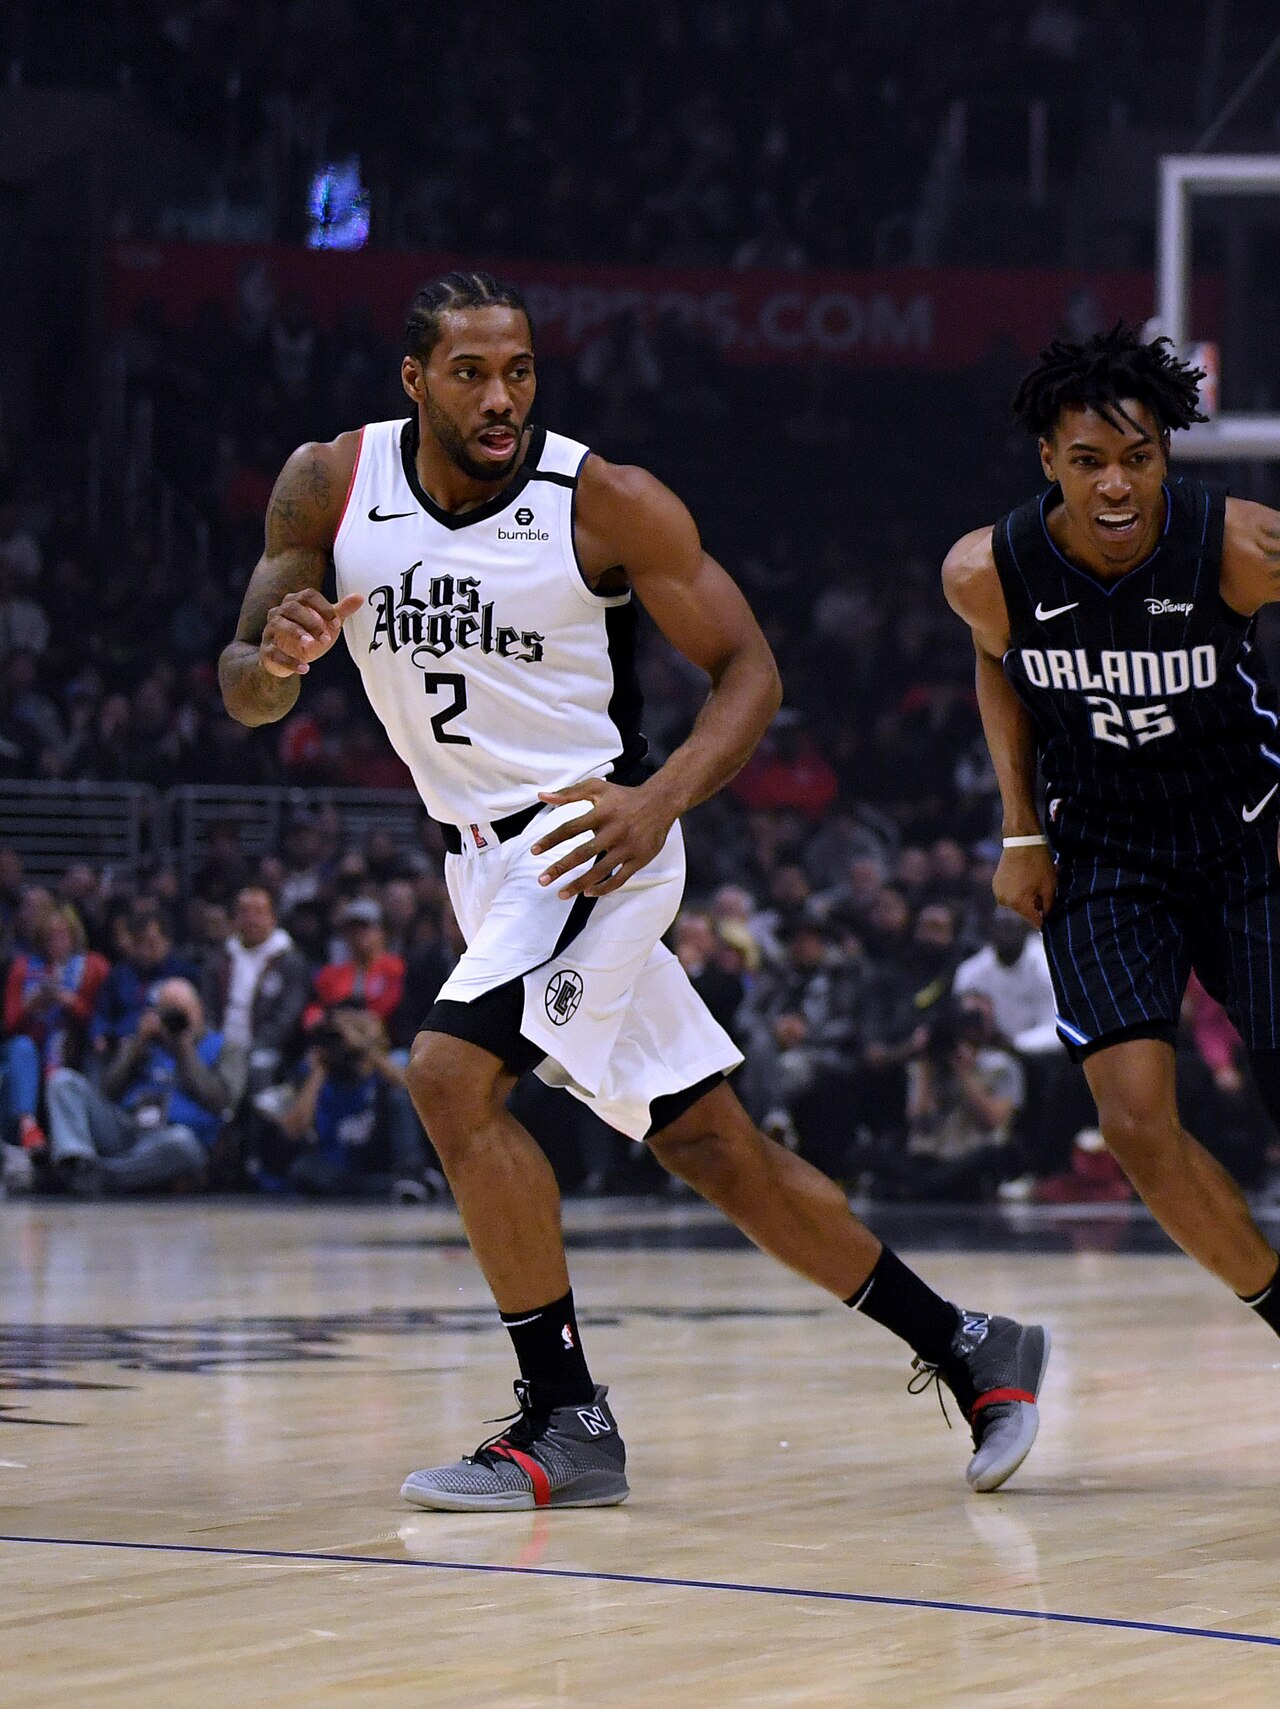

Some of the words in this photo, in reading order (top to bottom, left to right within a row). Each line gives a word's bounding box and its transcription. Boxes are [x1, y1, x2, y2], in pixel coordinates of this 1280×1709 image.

[498, 528, 549, 540] bumble
[396, 561, 481, 615] Los
[1144, 599, 1193, 616] Disney
[368, 586, 545, 669] Angeles
[1021, 645, 1217, 696] ORLANDO
[424, 672, 472, 746] 2
[1085, 696, 1176, 749] 25
[577, 1406, 611, 1436] N
